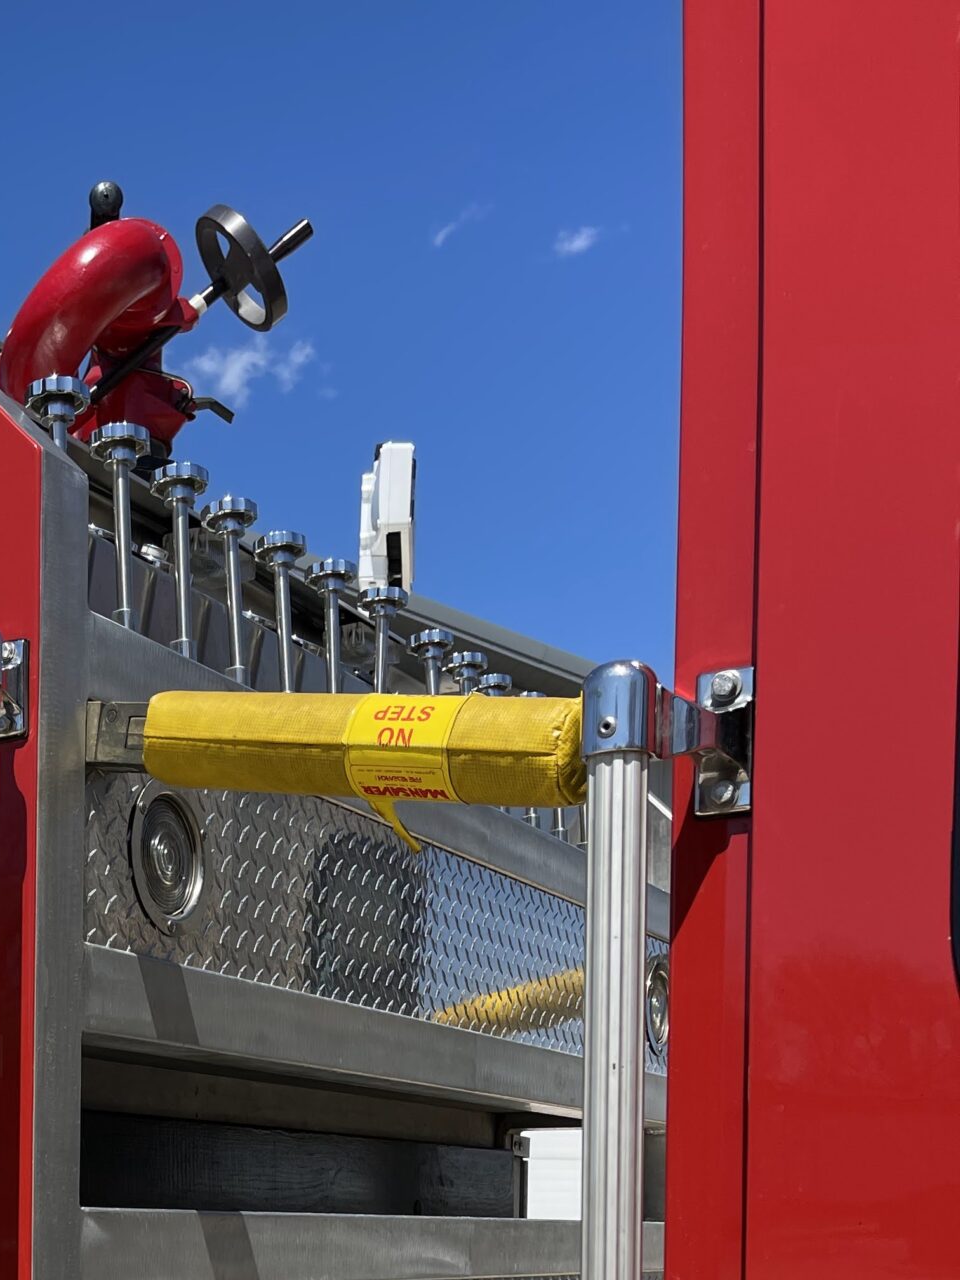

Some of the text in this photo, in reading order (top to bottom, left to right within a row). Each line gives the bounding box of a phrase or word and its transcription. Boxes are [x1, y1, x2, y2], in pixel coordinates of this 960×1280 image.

[373, 705, 435, 722] STEP
[377, 727, 414, 750] NO
[361, 786, 450, 800] MANSAVER
